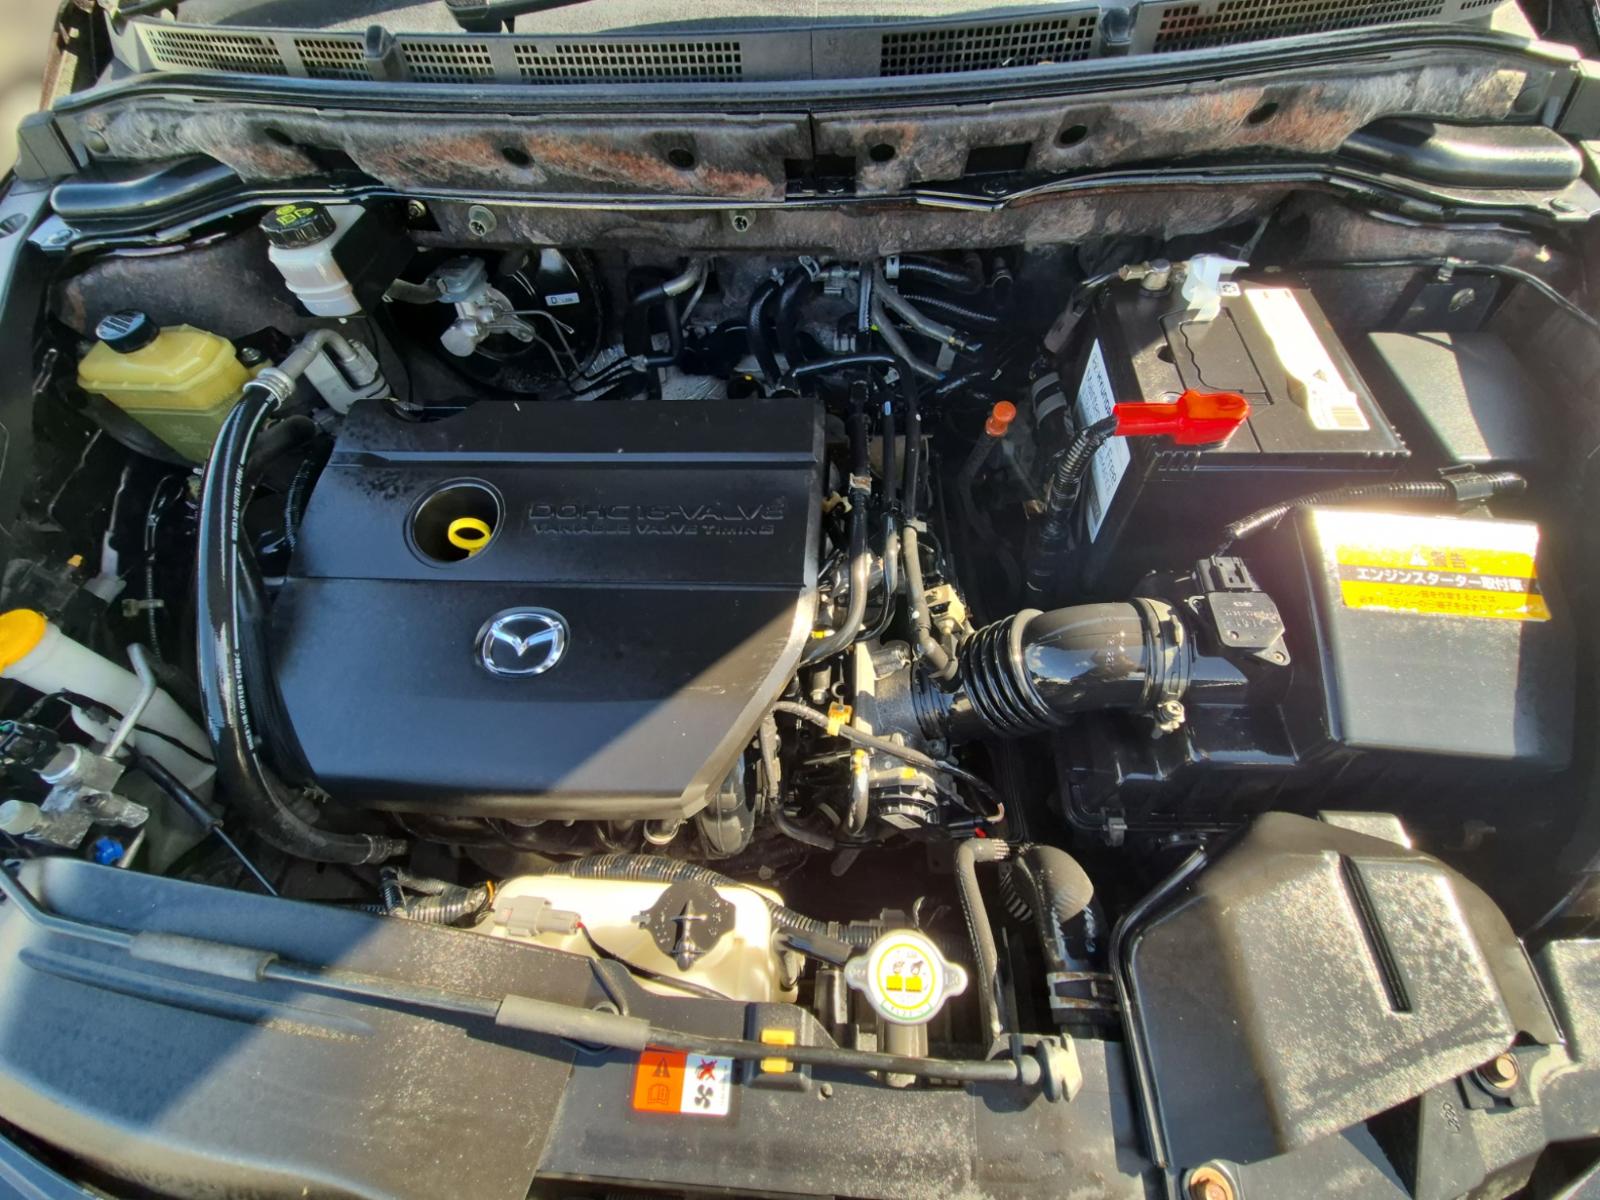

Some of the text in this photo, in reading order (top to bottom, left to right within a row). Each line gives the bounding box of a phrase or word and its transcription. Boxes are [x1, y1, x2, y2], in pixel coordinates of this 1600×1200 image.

[637, 503, 785, 521] 16-VALVE
[636, 524, 698, 535] VALVE
[702, 524, 775, 535] TIMING
[1430, 550, 1467, 569] 警告
[1356, 567, 1524, 593] エンジンスターター取付車
